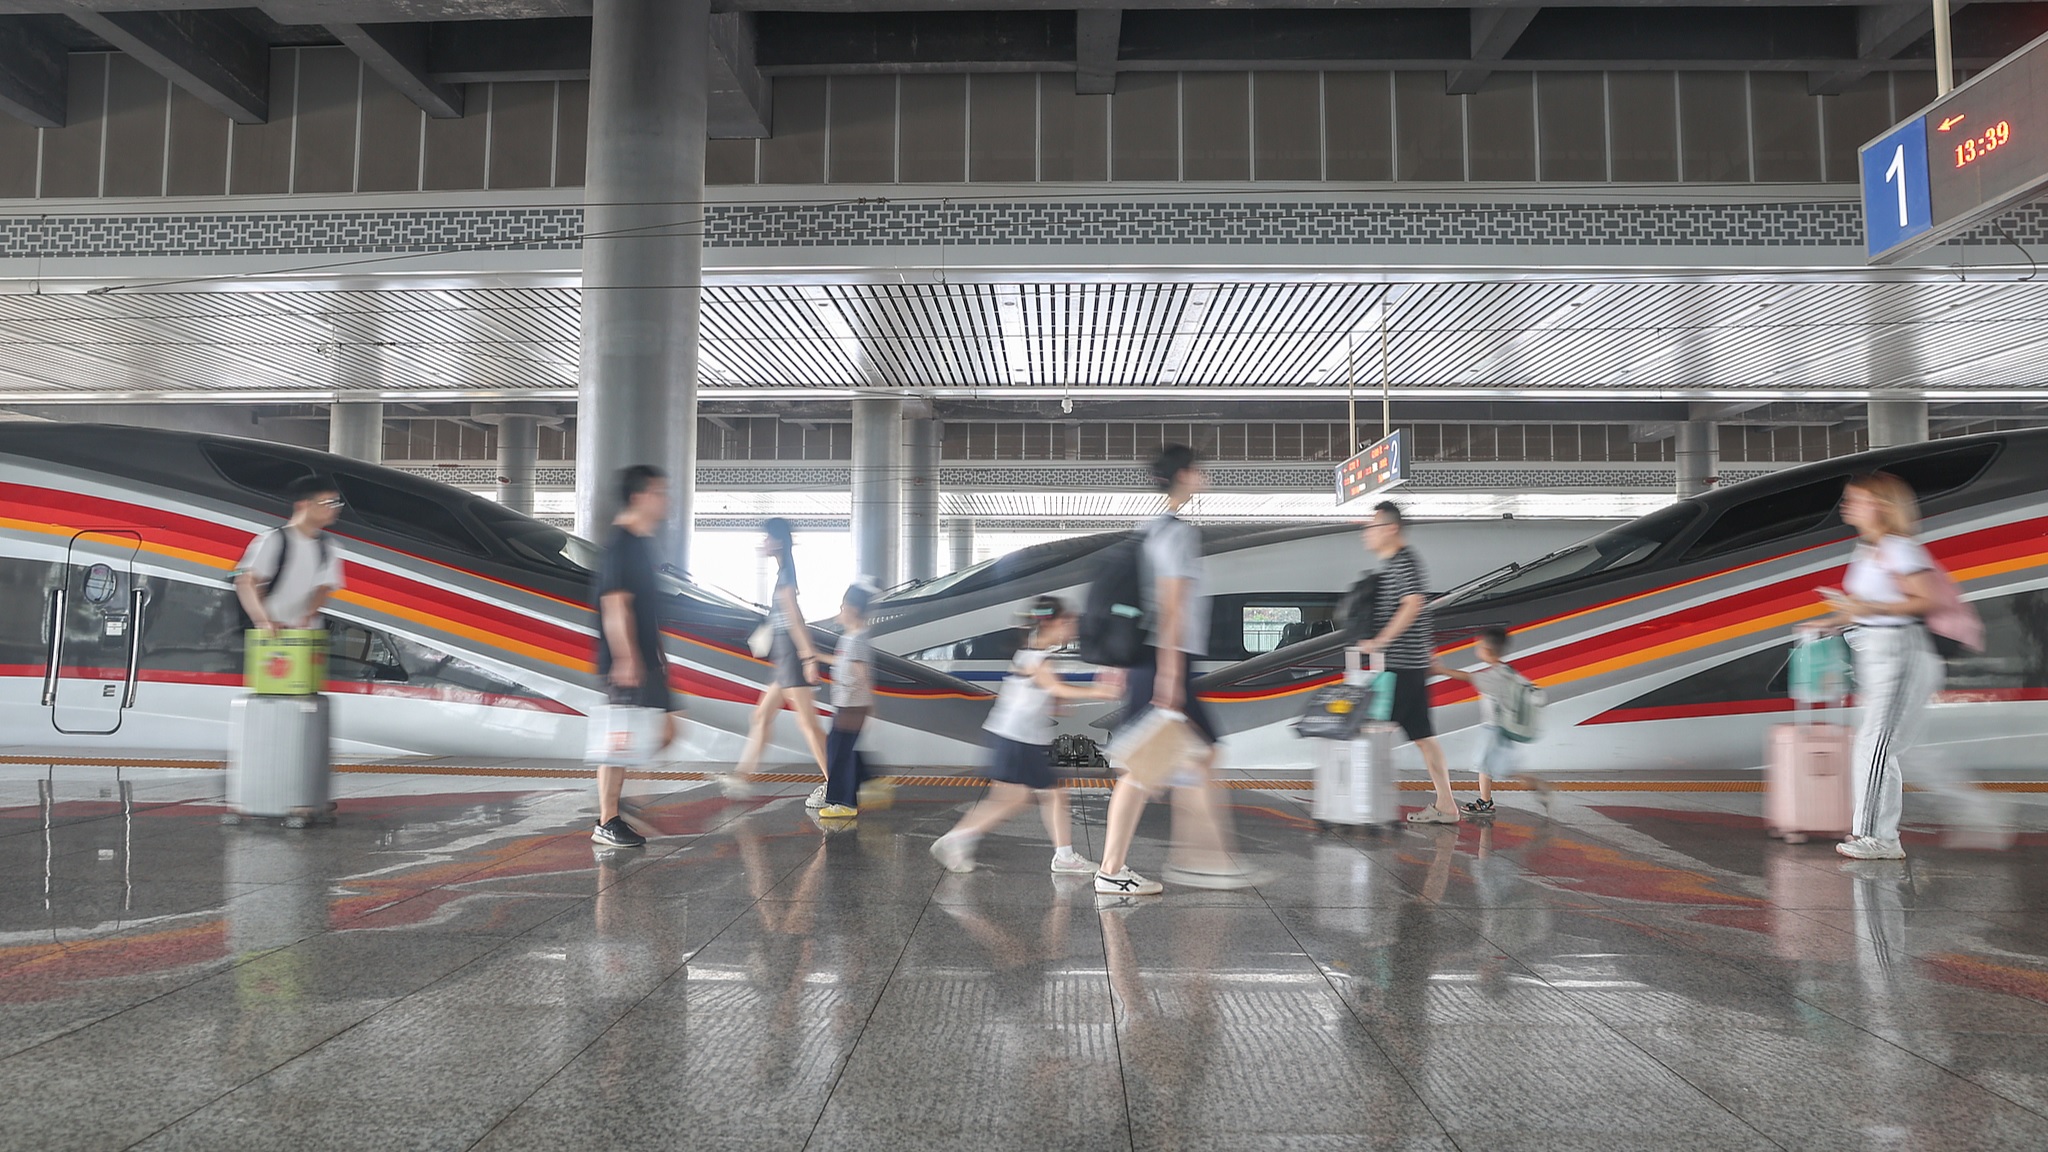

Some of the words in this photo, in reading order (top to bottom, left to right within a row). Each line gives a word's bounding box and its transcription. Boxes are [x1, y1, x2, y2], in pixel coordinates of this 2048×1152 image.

[1955, 121, 2010, 169] 13:39
[1885, 144, 1909, 228] 1
[1391, 440, 1398, 474] 2
